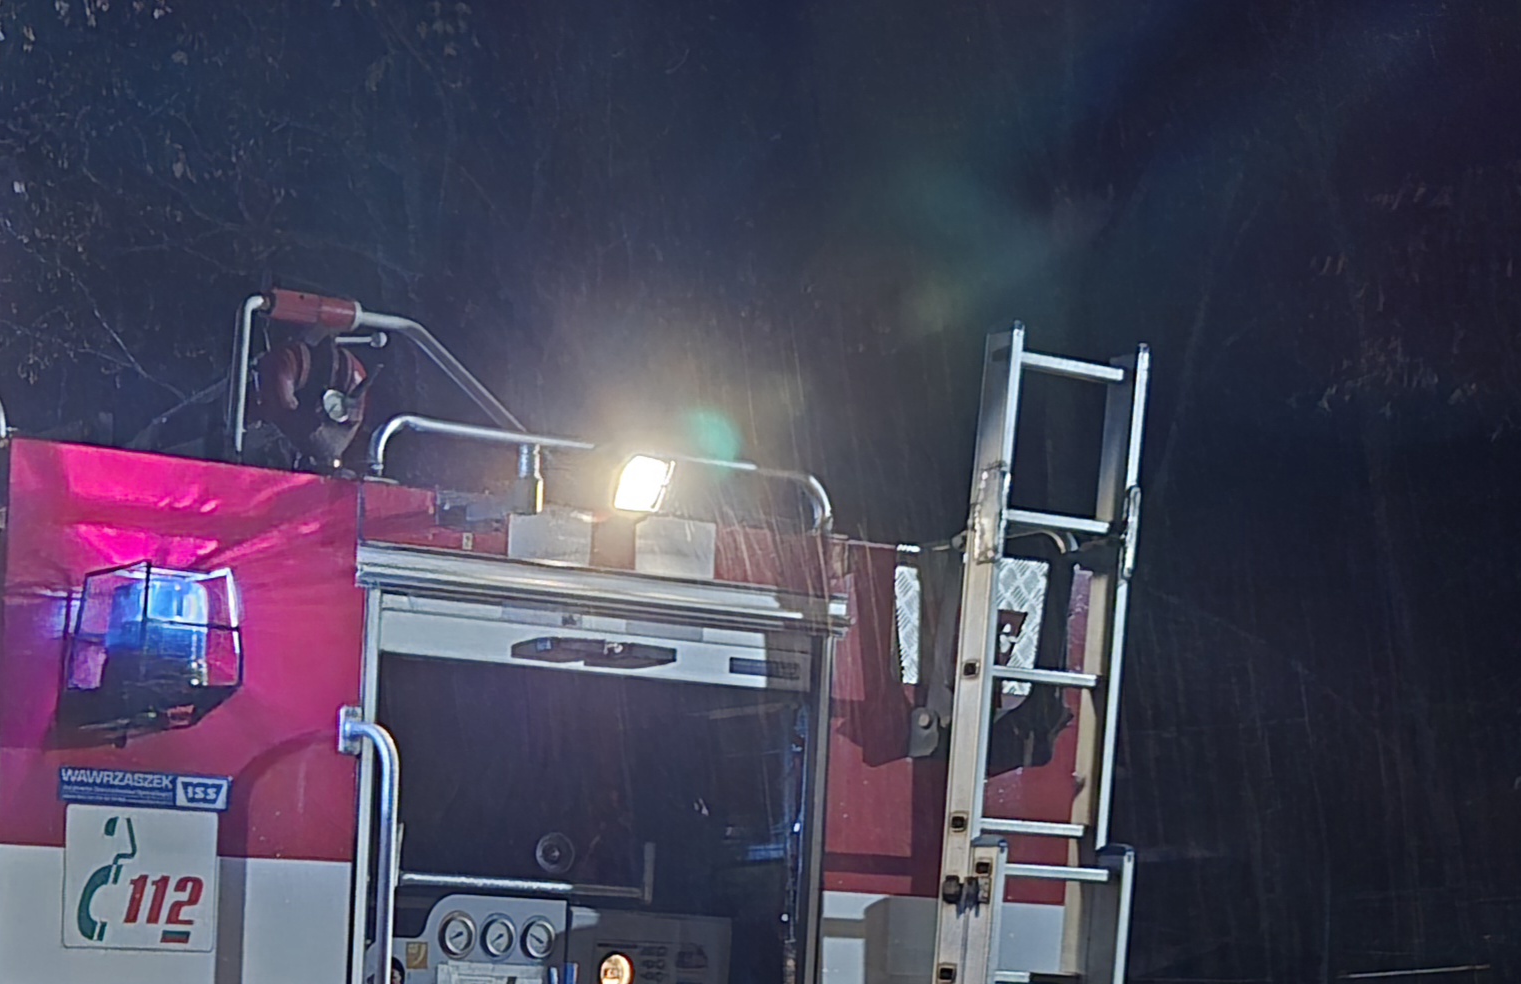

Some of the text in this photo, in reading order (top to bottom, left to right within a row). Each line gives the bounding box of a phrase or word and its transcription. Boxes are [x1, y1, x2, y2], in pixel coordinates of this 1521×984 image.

[61, 768, 173, 789] WAWRZASZEK
[187, 785, 217, 800] ISS
[124, 874, 204, 925] 112
